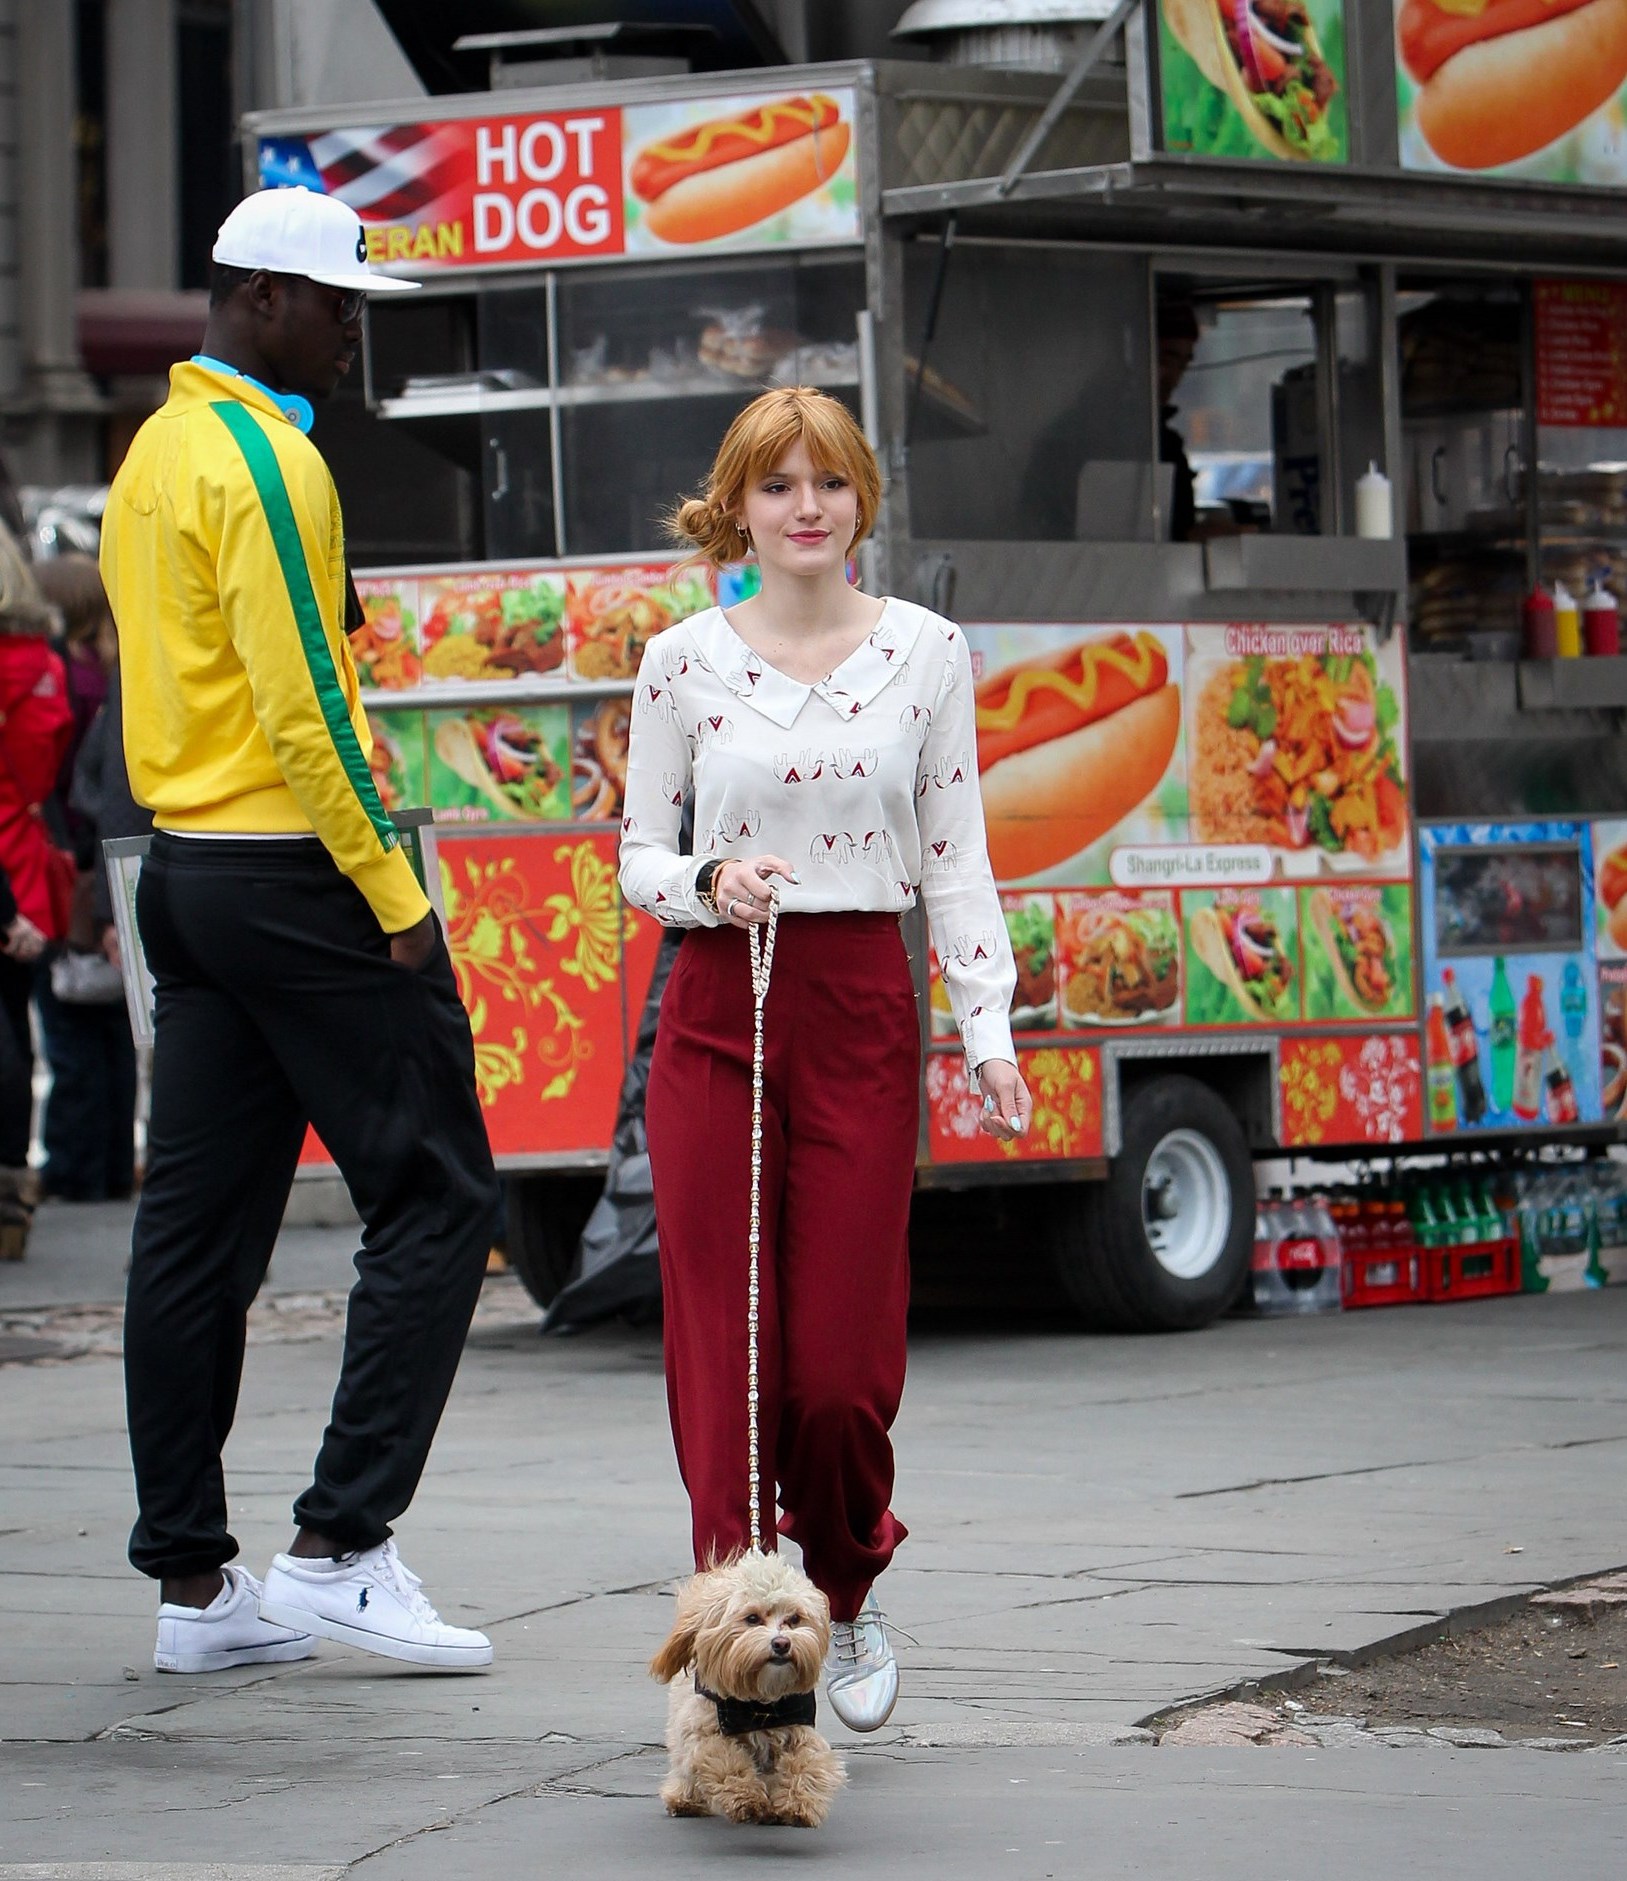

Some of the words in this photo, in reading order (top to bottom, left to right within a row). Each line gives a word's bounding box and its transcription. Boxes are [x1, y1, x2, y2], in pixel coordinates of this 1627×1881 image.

[476, 118, 604, 184] HOT
[474, 185, 611, 253] DOG
[367, 220, 463, 263] ERAN
[1225, 624, 1286, 656] Chicken
[1290, 630, 1326, 655] over
[1328, 623, 1364, 655] Rice
[1126, 853, 1201, 879] Shangri-La
[1205, 851, 1261, 875] Express
